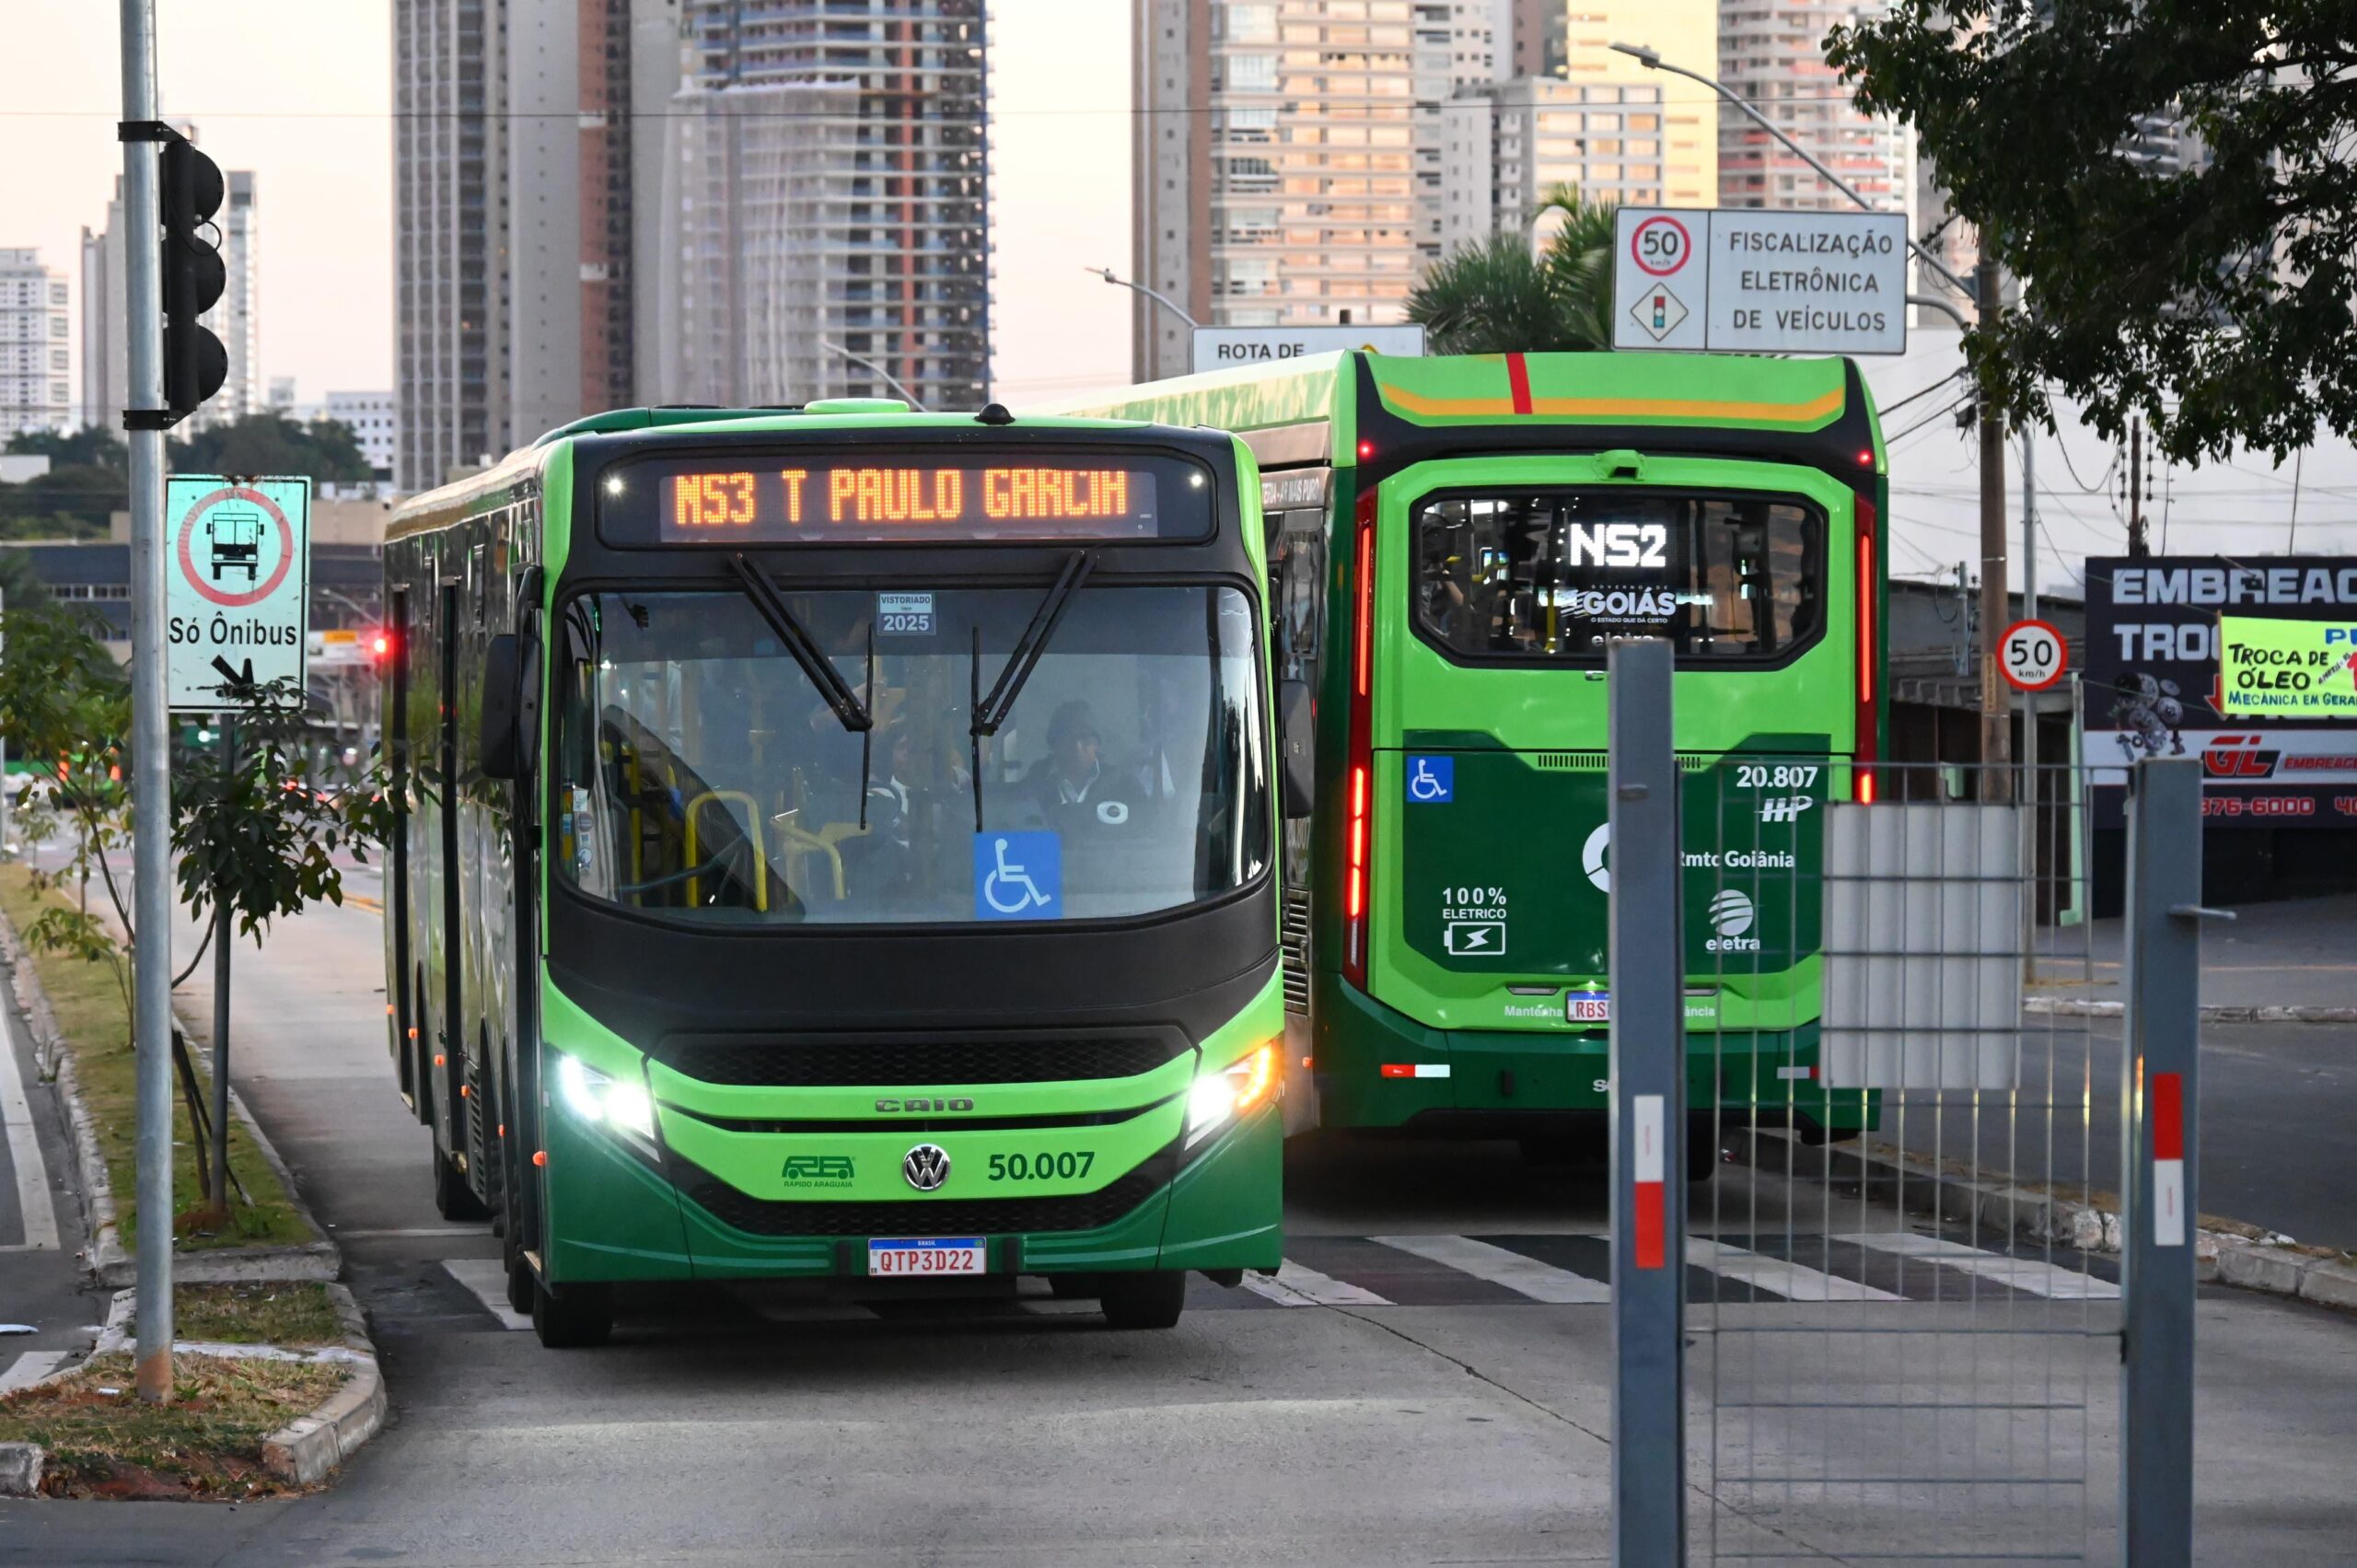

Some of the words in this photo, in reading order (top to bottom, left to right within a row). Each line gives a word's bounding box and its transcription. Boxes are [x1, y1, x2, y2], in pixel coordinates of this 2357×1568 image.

[1643, 231, 1678, 255] 50
[1730, 229, 1893, 259] FISCALIZAÇÃO
[1741, 266, 1879, 293] ELETRÔNICA
[1733, 309, 1762, 329] DE
[1776, 305, 1887, 331] VEÍCULOS
[1218, 343, 1271, 359] ROTA
[1279, 343, 1305, 359] DE
[782, 470, 807, 522] T
[830, 469, 961, 521] PAULO
[1570, 523, 1666, 567] NS2
[881, 596, 931, 604] VISTORIADO
[1583, 586, 1677, 616] GOIÁS
[168, 617, 200, 645] Só
[210, 610, 296, 645] Ônibus
[883, 614, 930, 632] 2025
[2011, 639, 2053, 667] 50
[2113, 623, 2220, 661] TRO
[2228, 644, 2303, 666] TROCA
[2308, 650, 2329, 667] DE
[2018, 668, 2046, 678] km/h
[2237, 666, 2311, 691] ÓLEO
[2303, 694, 2319, 705] EM
[1736, 765, 1818, 788] 20.807
[1724, 850, 1795, 868] Goiânia
[1443, 887, 1507, 905] 100%
[1443, 908, 1507, 919] ELETRICO
[1705, 935, 1760, 951] eletra
[1576, 1001, 1611, 1018] RBS
[1684, 1005, 1715, 1017] ância
[876, 1097, 974, 1112] CAIO
[988, 1152, 1096, 1181] 50.007
[880, 1250, 974, 1272] QTP3D22
